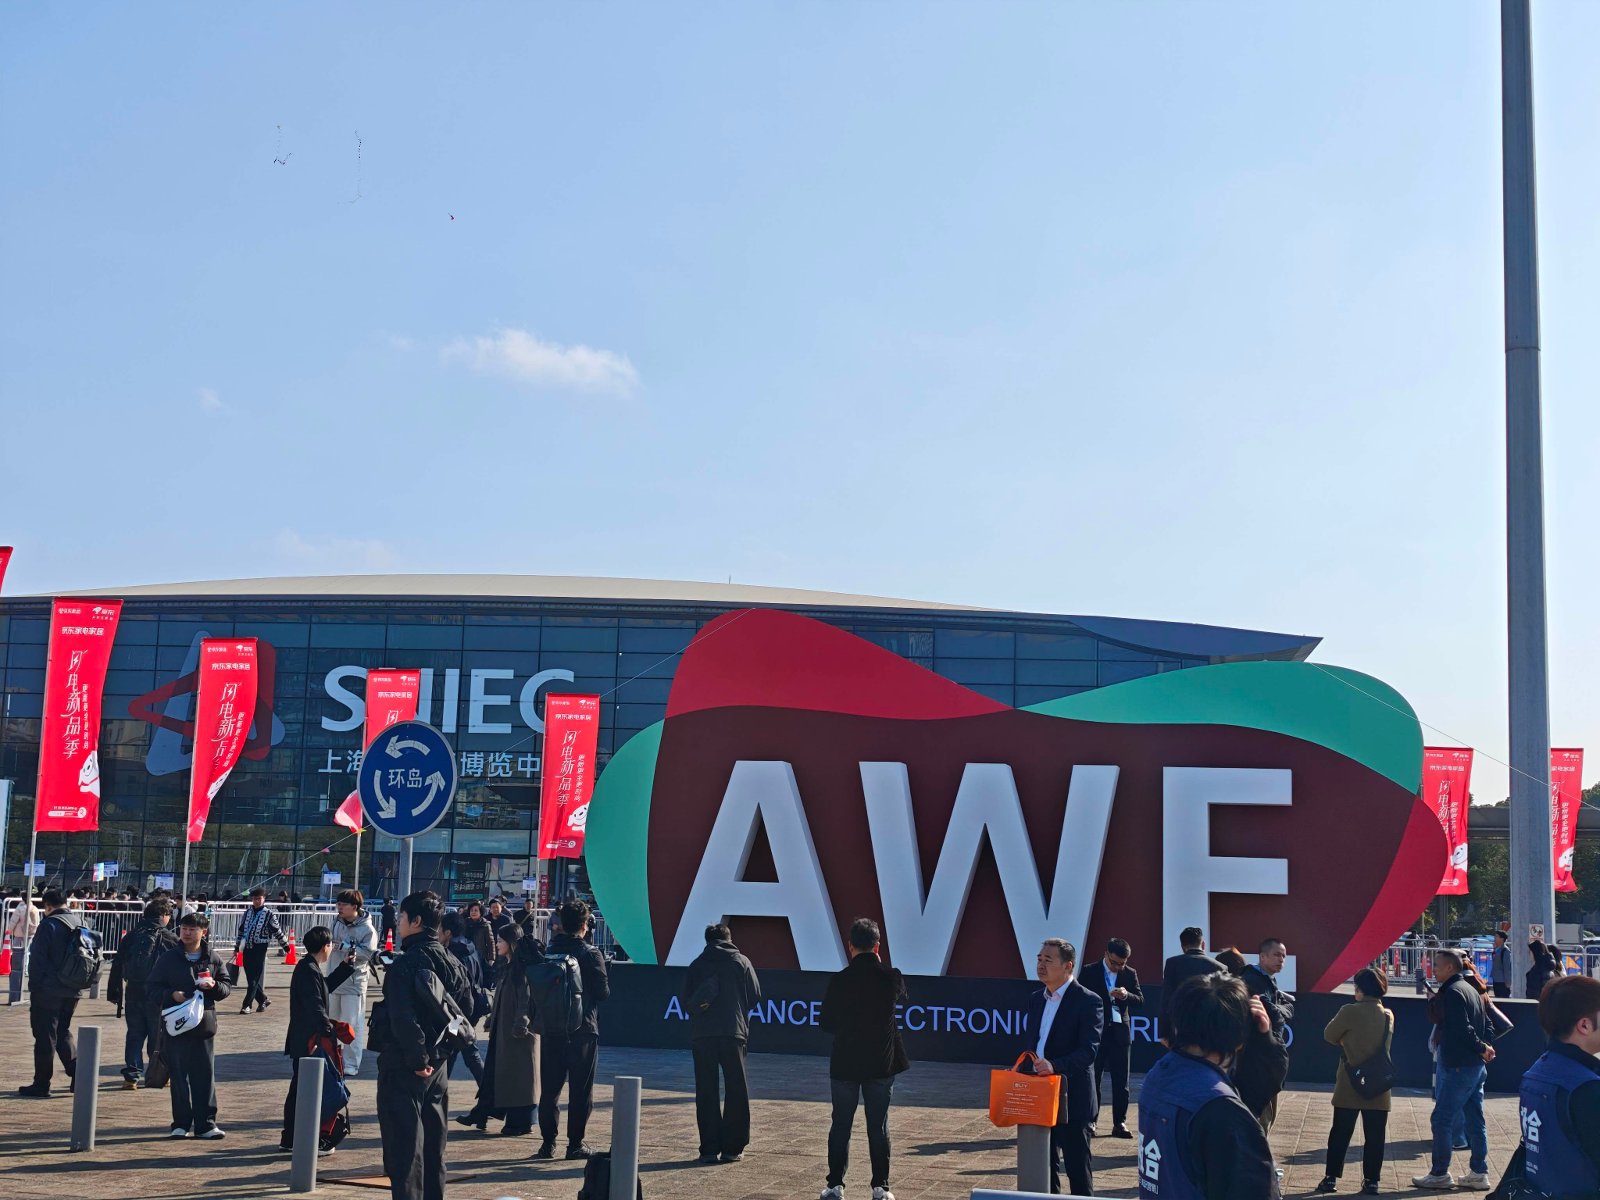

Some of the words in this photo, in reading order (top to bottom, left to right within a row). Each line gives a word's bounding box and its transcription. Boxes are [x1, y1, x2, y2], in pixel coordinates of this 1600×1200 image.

[61, 626, 105, 636] 京东家电家居
[60, 649, 89, 759] 闪电新品季
[318, 749, 541, 779] 上海博览中
[388, 768, 423, 789] 环岛
[665, 760, 1297, 992] AWE
[663, 995, 823, 1026] AANCE
[895, 1004, 1029, 1035] CTRONI
